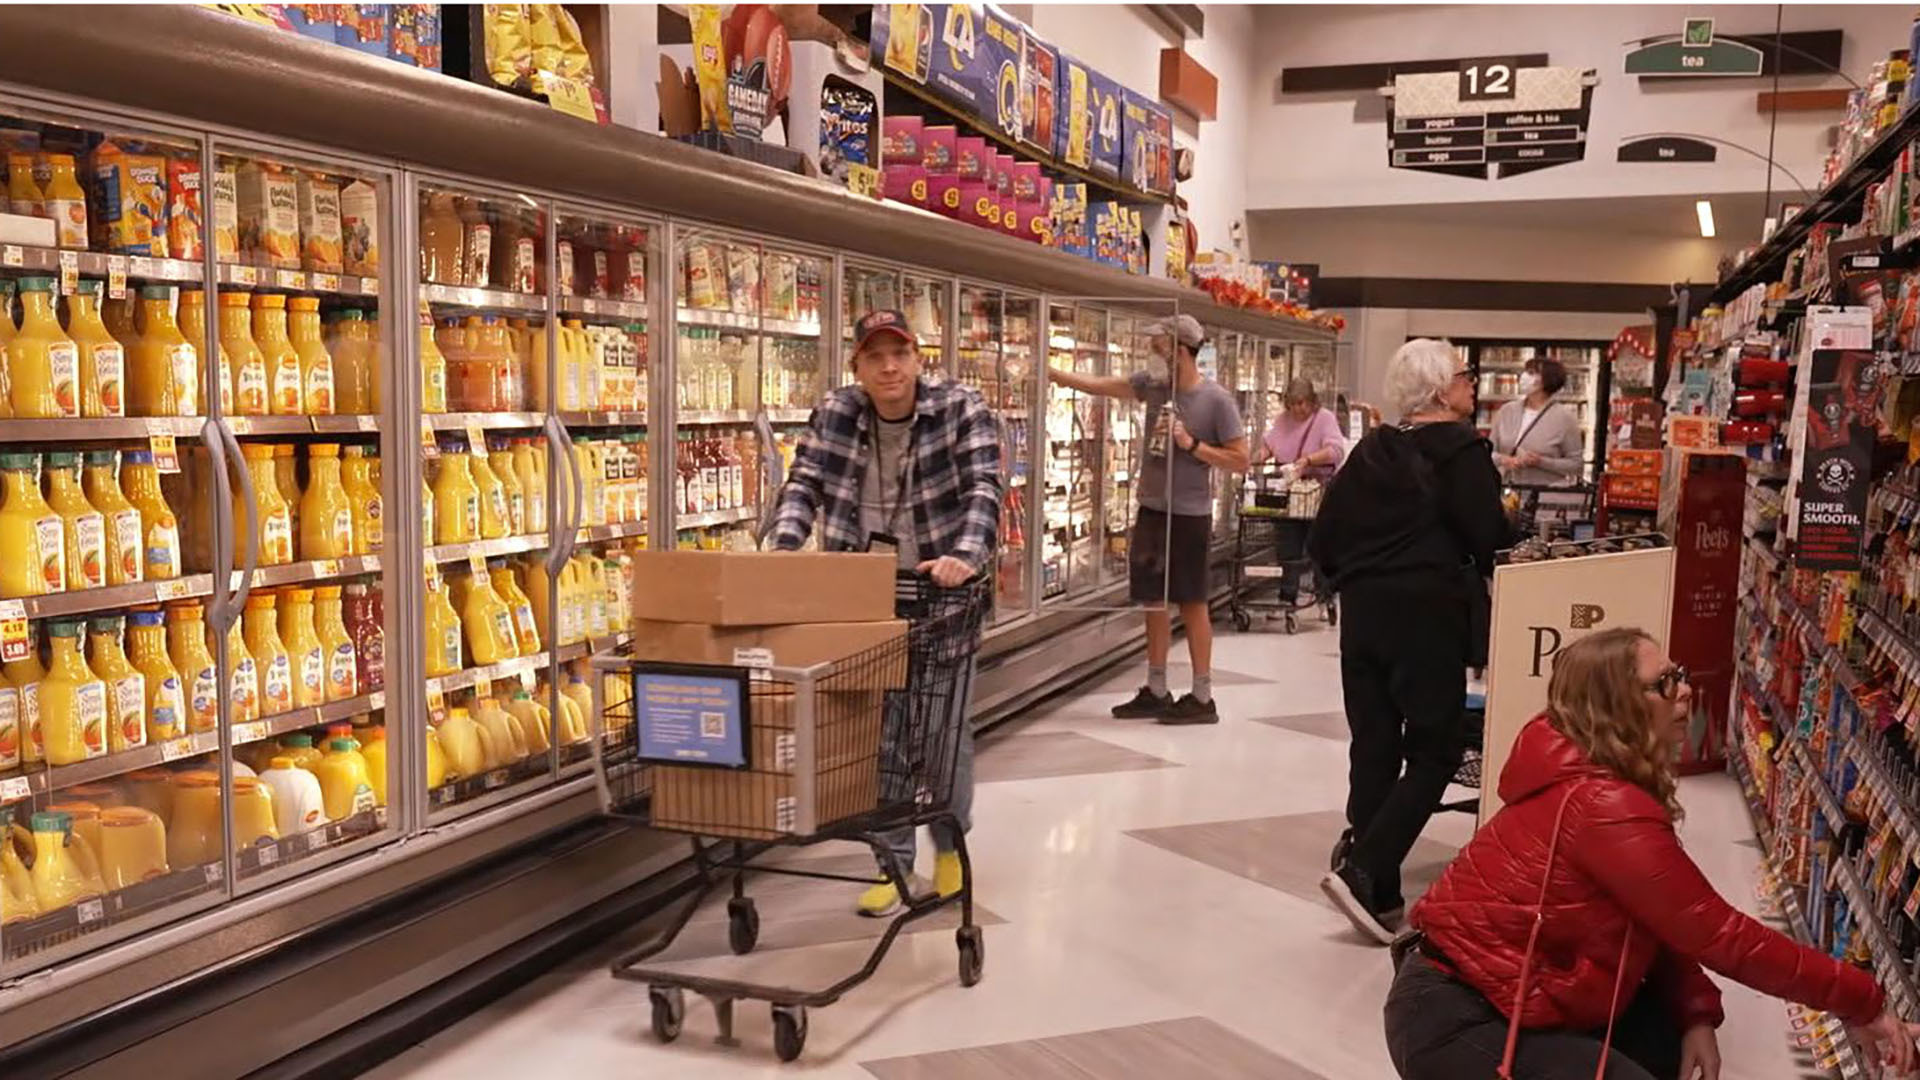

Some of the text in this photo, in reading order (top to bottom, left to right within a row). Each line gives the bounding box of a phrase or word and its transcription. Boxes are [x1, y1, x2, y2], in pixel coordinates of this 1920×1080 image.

[1682, 55, 1704, 67] tea
[1465, 65, 1511, 94] 12
[1425, 118, 1455, 128] yogurt
[1506, 114, 1560, 125] coffee & tea
[1425, 136, 1452, 145] butter
[1524, 132, 1539, 140] tea
[1428, 153, 1449, 161] eggs
[1658, 147, 1676, 157] tea
[1803, 502, 1844, 513] SUPER
[1803, 513, 1861, 525] SMOOTH.
